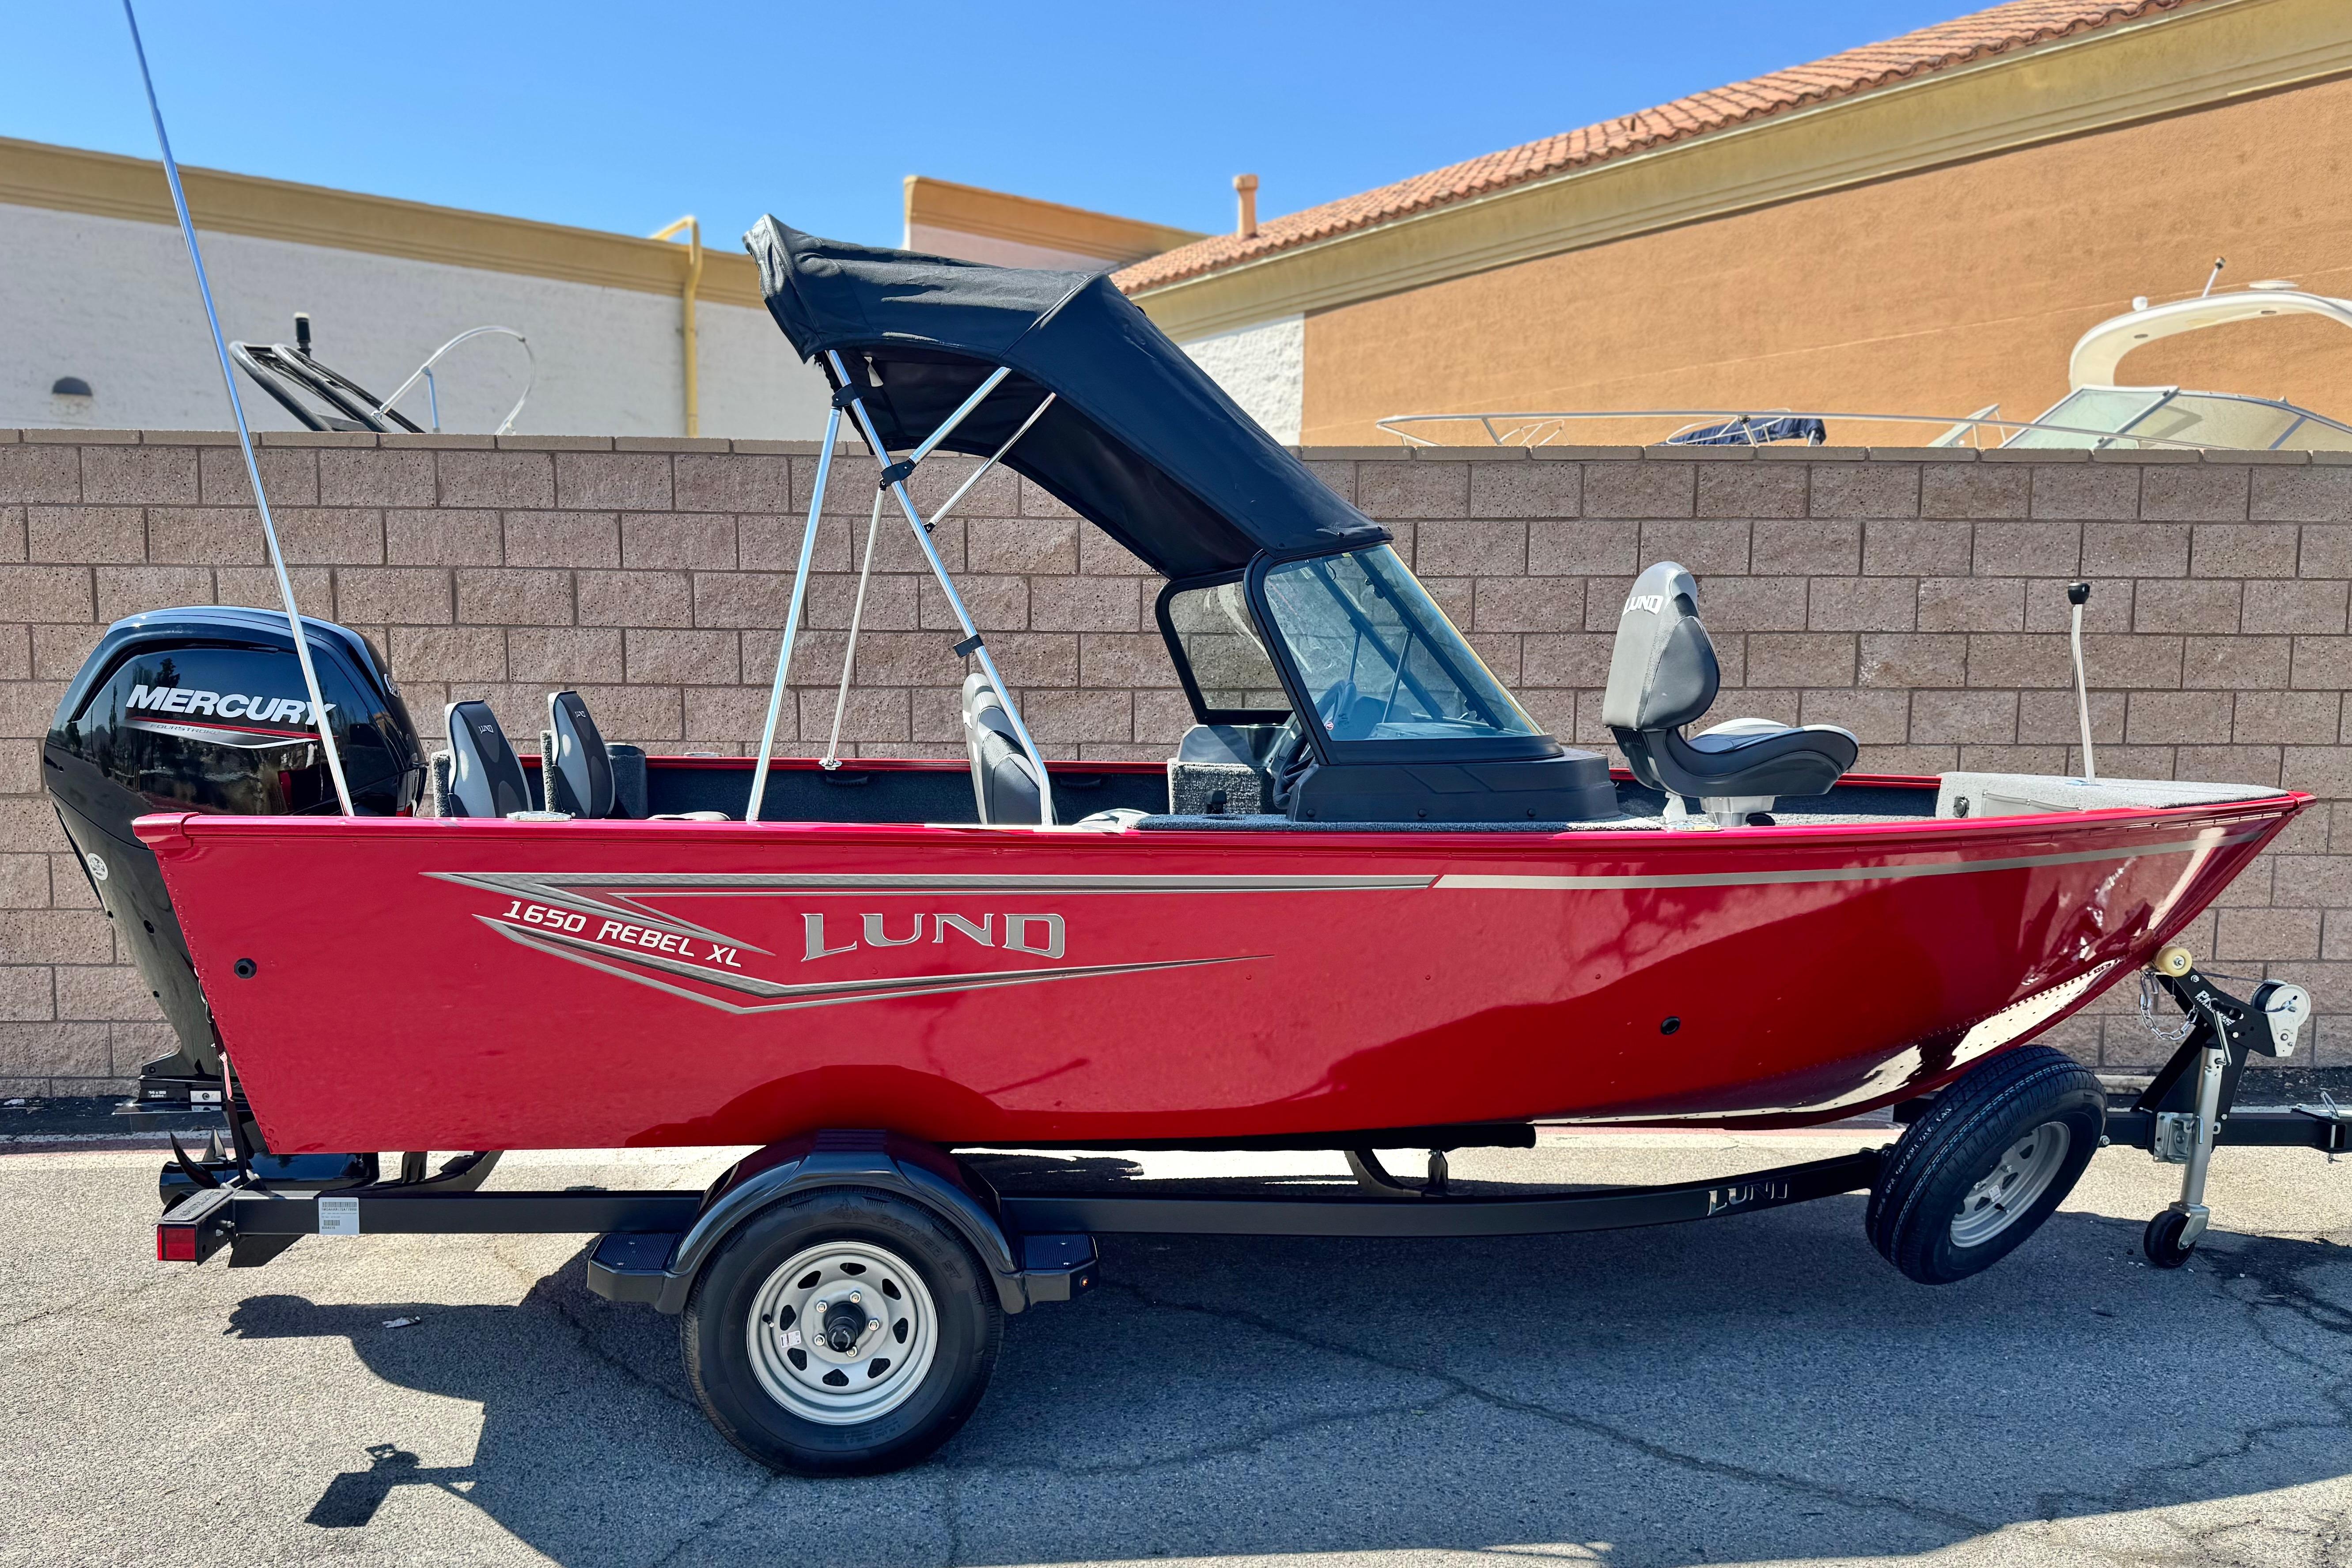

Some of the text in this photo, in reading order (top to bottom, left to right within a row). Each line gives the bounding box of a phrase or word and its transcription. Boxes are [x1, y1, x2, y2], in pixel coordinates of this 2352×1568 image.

[1622, 595, 1663, 615] LUND
[125, 684, 337, 726] MERCURY
[150, 723, 220, 735] FOURSTROKE
[502, 900, 742, 968] 1650 REBEL XL
[800, 913, 1066, 962] LUND
